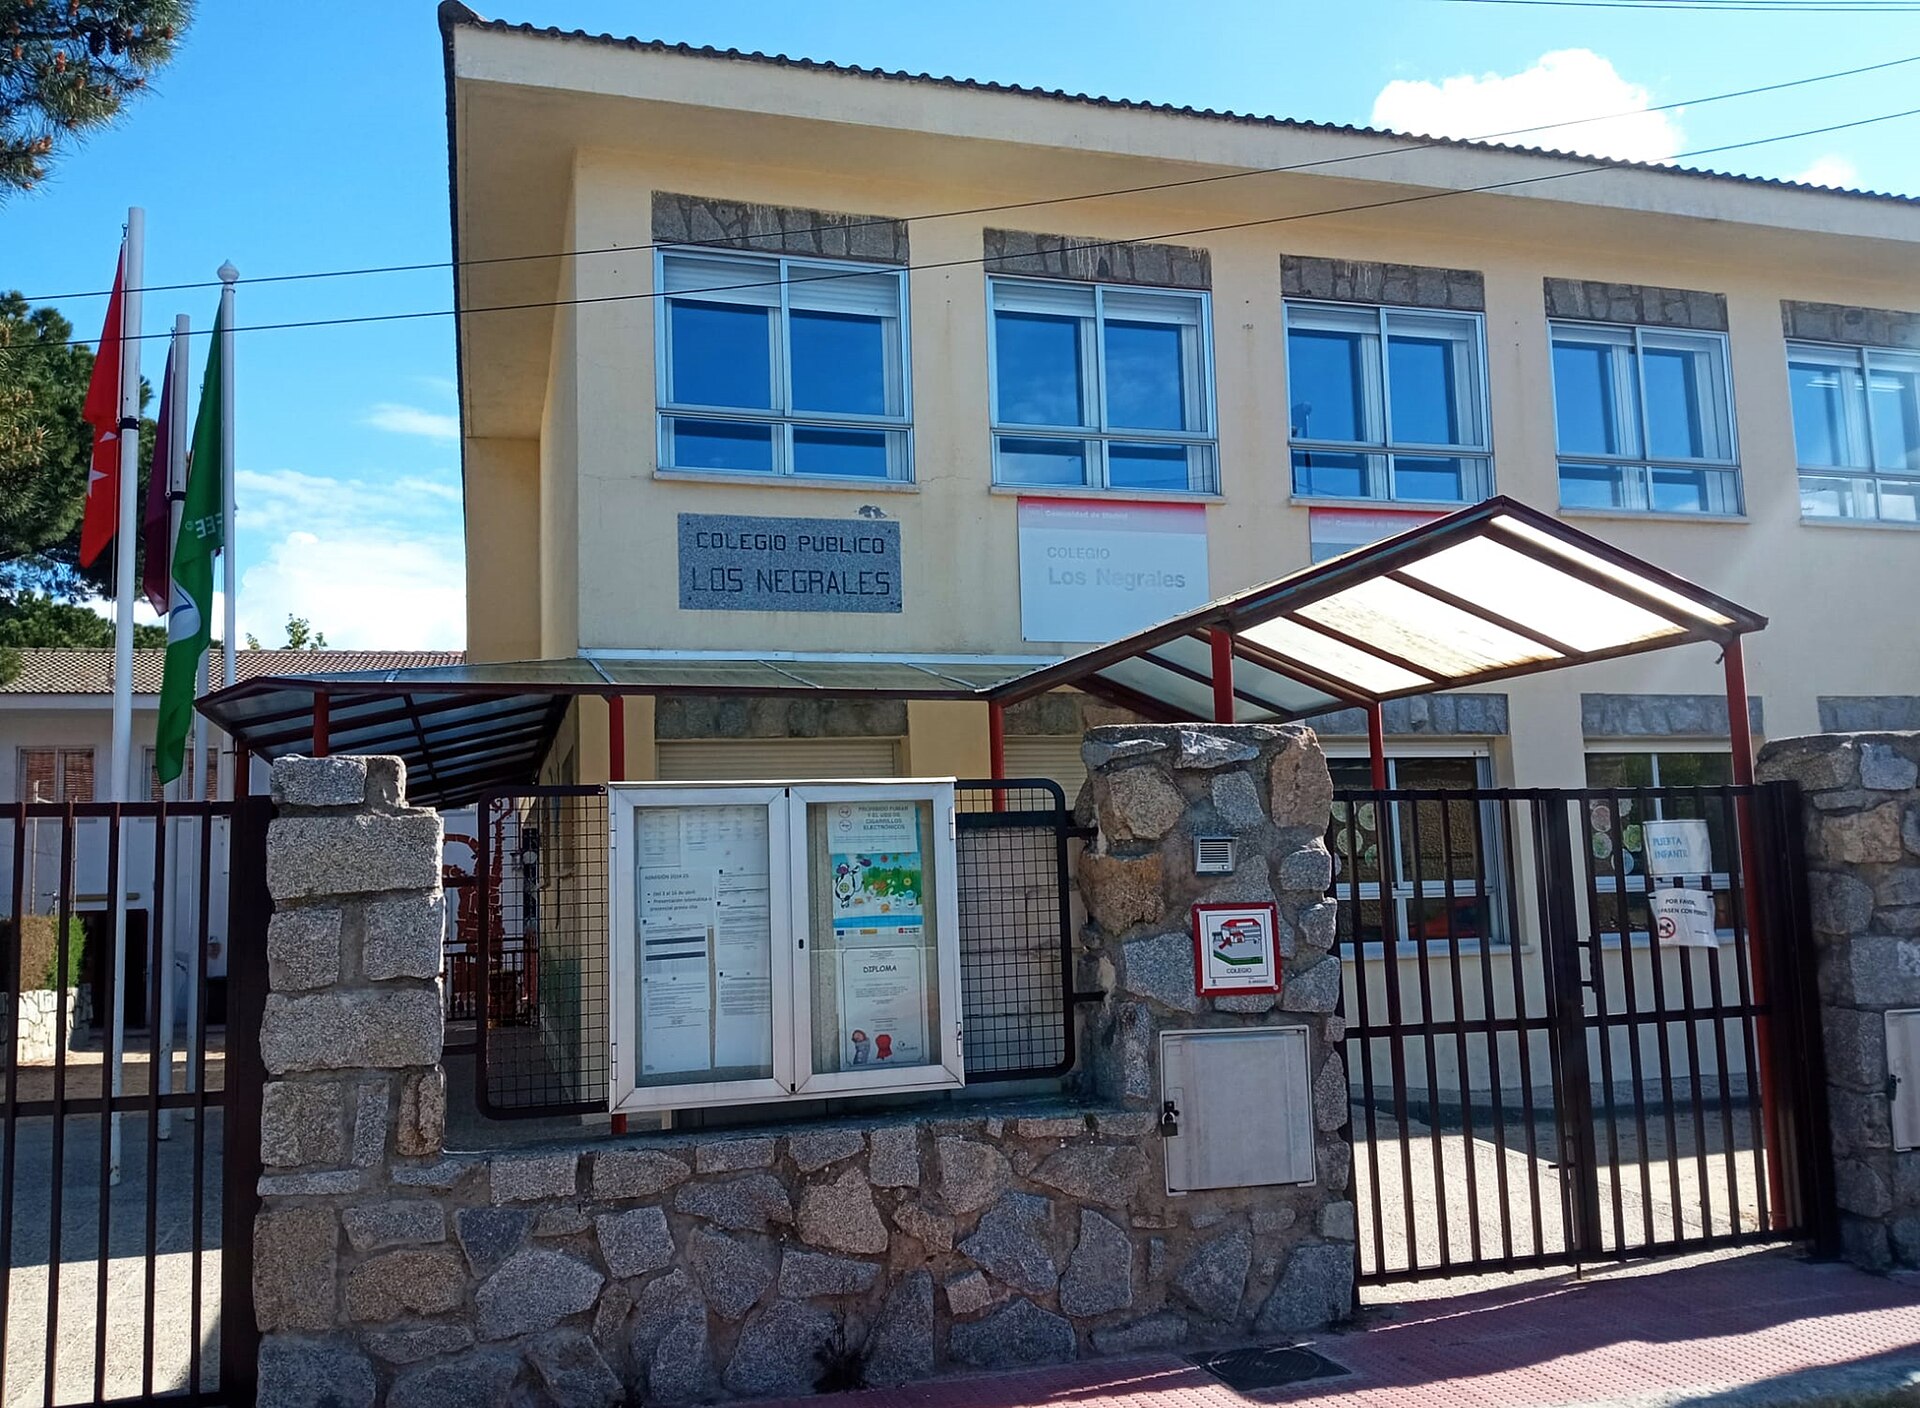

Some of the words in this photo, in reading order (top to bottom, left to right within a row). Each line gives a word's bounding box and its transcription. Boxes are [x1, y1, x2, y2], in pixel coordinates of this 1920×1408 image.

[697, 532, 786, 551] COLEGIO
[798, 535, 885, 554] PUBLICO
[1047, 546, 1111, 560] COLEGIO
[692, 567, 743, 592] LOS
[756, 568, 890, 595] NEGRALES
[1047, 567, 1087, 586] Los
[1096, 568, 1186, 591] Negrales
[863, 964, 897, 974] DIPLOMA
[1226, 967, 1252, 975] COLEGIO
